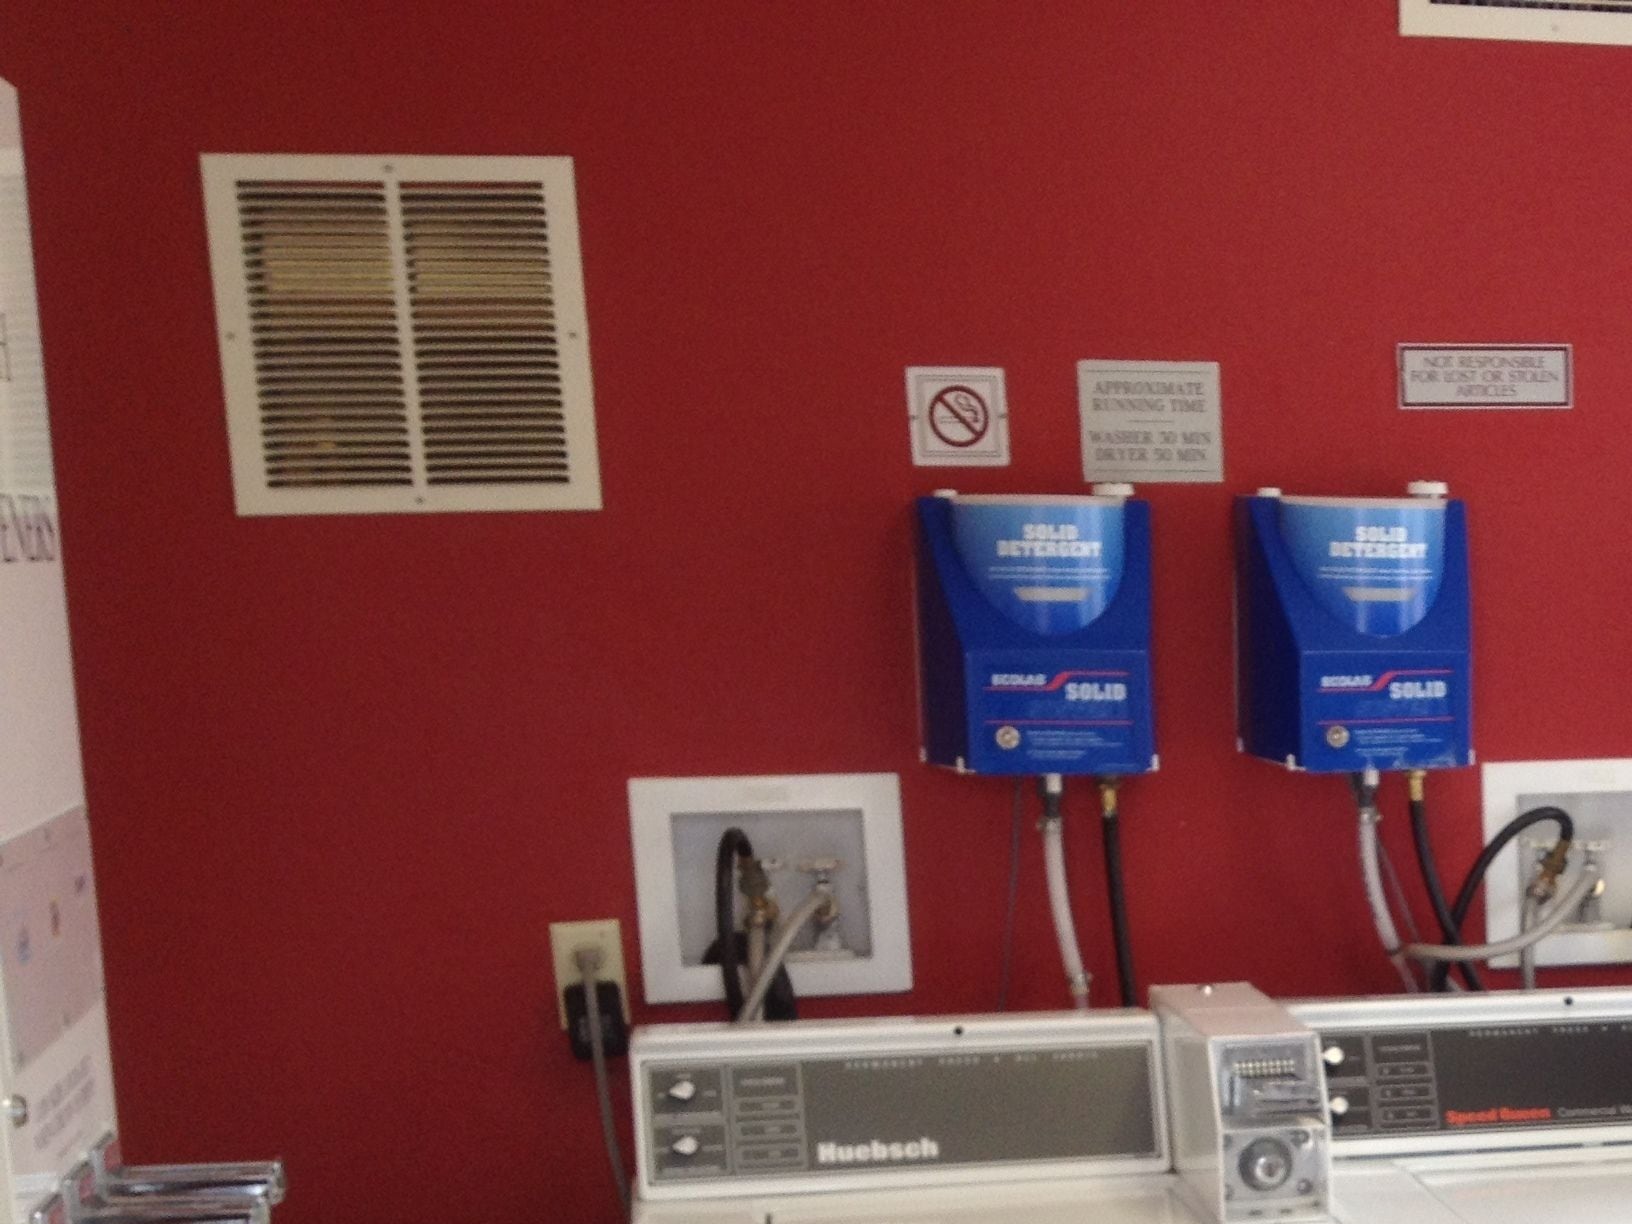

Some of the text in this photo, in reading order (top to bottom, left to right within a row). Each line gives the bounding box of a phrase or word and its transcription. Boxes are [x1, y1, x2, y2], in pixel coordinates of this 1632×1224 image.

[1424, 356, 1545, 369] NOT RESPONSIBLE
[1410, 370, 1560, 384] FOR LOST OR STOLEN
[1456, 384, 1518, 397] ARTICLES
[1092, 397, 1206, 413] RUNNING TIME
[1088, 429, 1154, 445] WASHER
[1181, 430, 1212, 445] MIN
[1096, 447, 1149, 462] DRYER
[1176, 448, 1207, 462] MIN
[1022, 523, 1080, 541] SOLID
[1355, 525, 1408, 542] SOLID
[996, 540, 1102, 557] DETERGENT
[1328, 541, 1427, 558] DETERGENT
[1065, 682, 1127, 701] SOLID
[1389, 680, 1447, 699] SOLID
[817, 1136, 940, 1164] Huebsch
